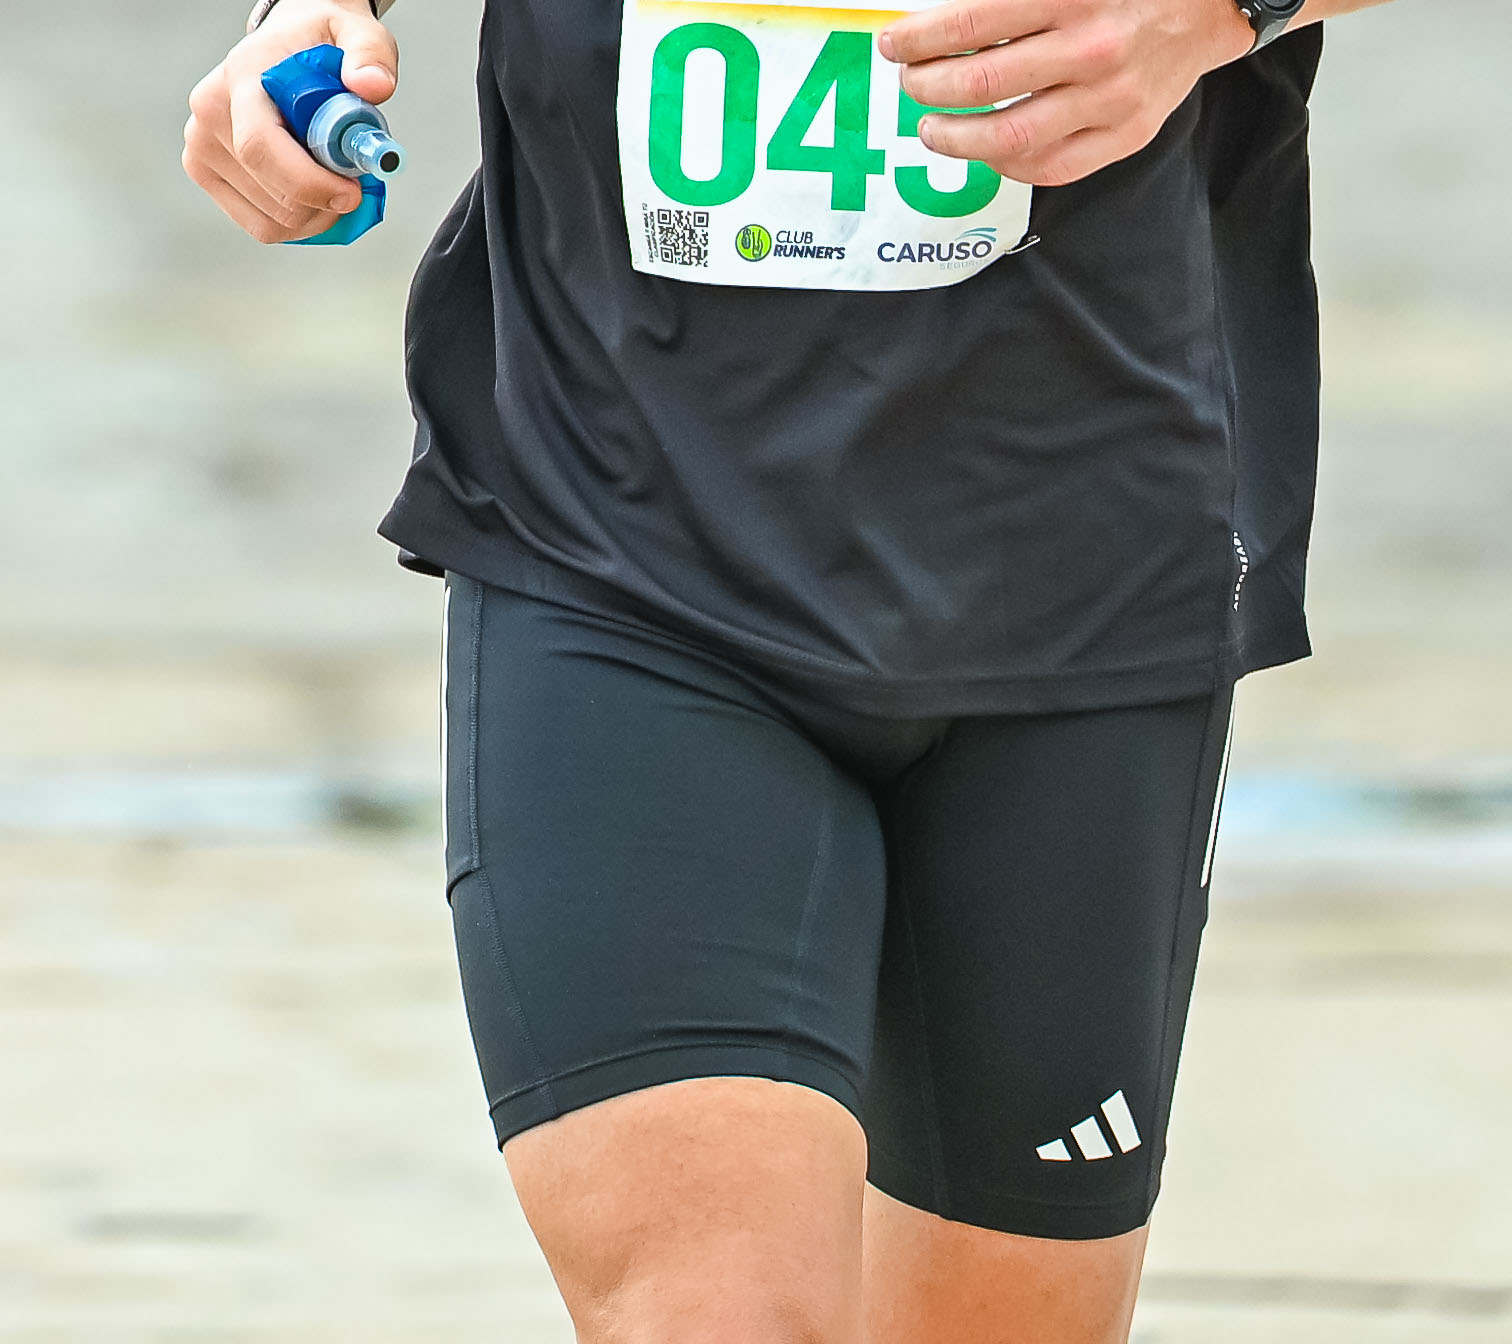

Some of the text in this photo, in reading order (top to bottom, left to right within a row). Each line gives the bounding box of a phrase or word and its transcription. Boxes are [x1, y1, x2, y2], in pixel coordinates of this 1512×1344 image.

[649, 22, 1001, 218] 045
[776, 230, 813, 244] CLUB
[773, 244, 845, 260] RUNNER'S
[877, 240, 992, 263] CARUSO
